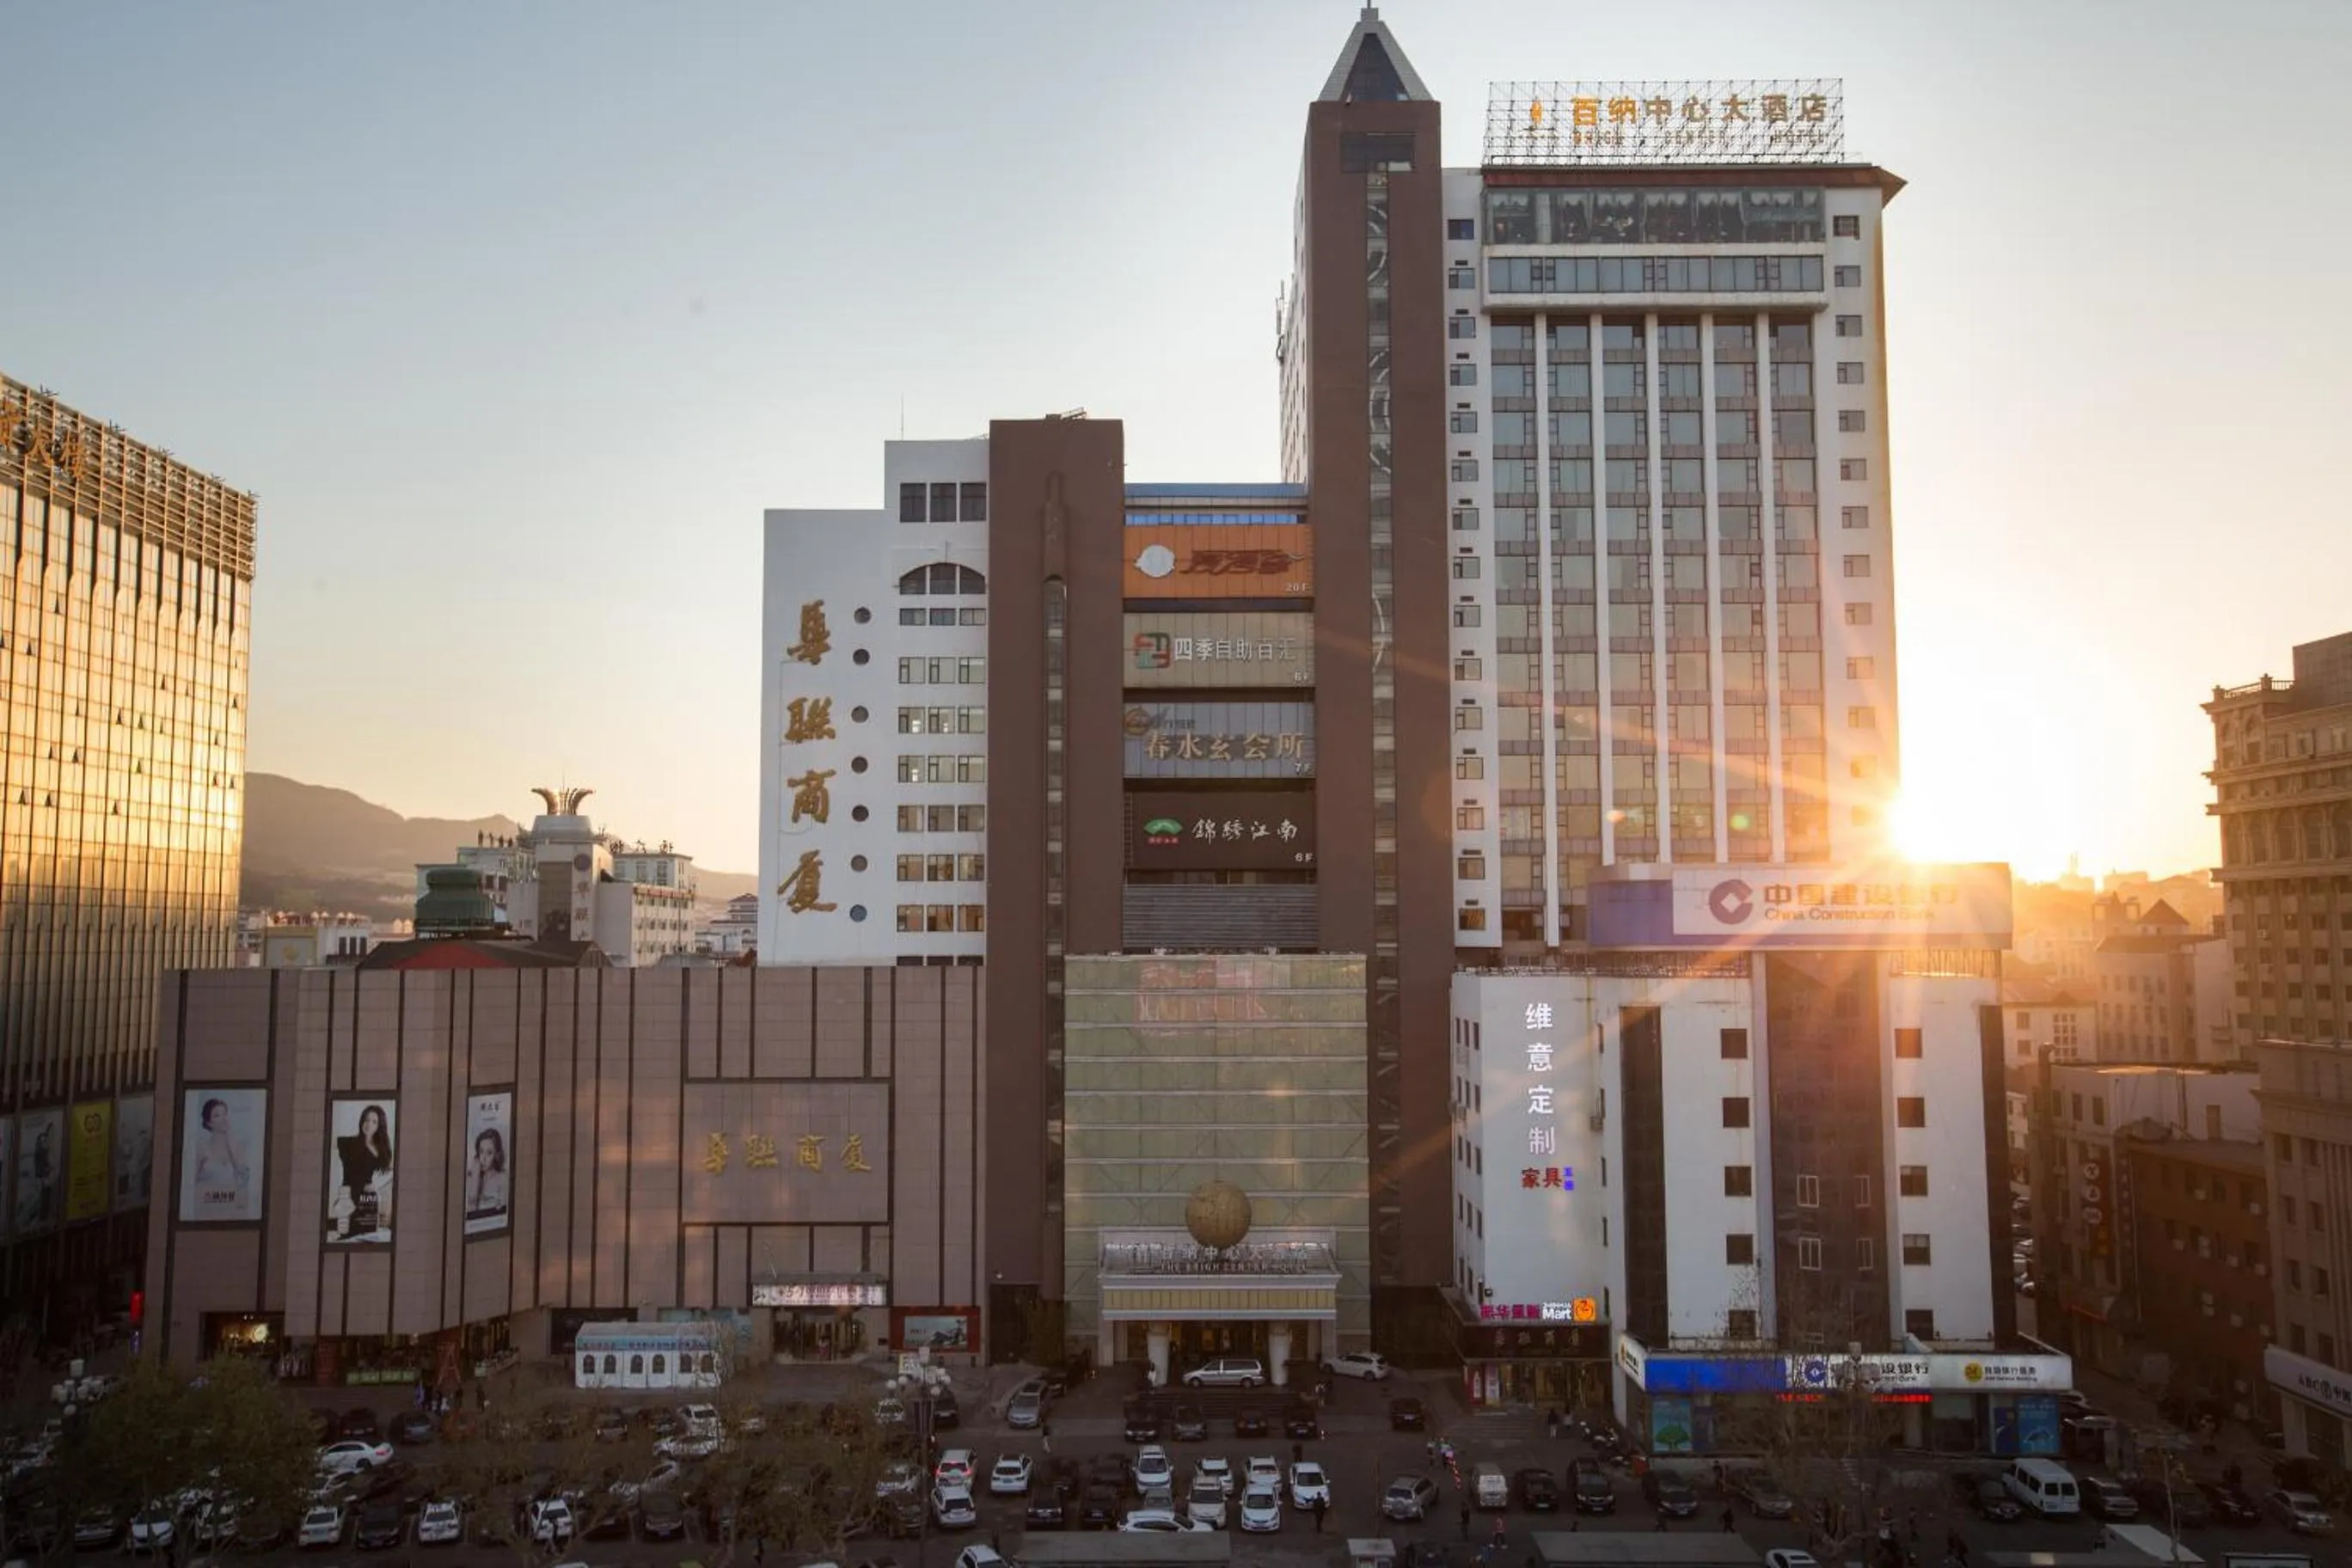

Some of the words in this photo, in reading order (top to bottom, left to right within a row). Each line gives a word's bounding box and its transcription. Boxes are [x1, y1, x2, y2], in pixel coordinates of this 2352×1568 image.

[1572, 94, 1827, 126] 百纳中心大酒店
[1774, 130, 1825, 144] HOTEL
[1174, 638, 1296, 662] 四季自助百汇
[1764, 884, 1959, 907] 中国建设银行
[1765, 908, 1804, 922] China
[1809, 908, 1896, 922] Construction
[1525, 1002, 1556, 1155] 维意定制
[1521, 1167, 1563, 1189] 家具
[1543, 1308, 1572, 1320] Mart
